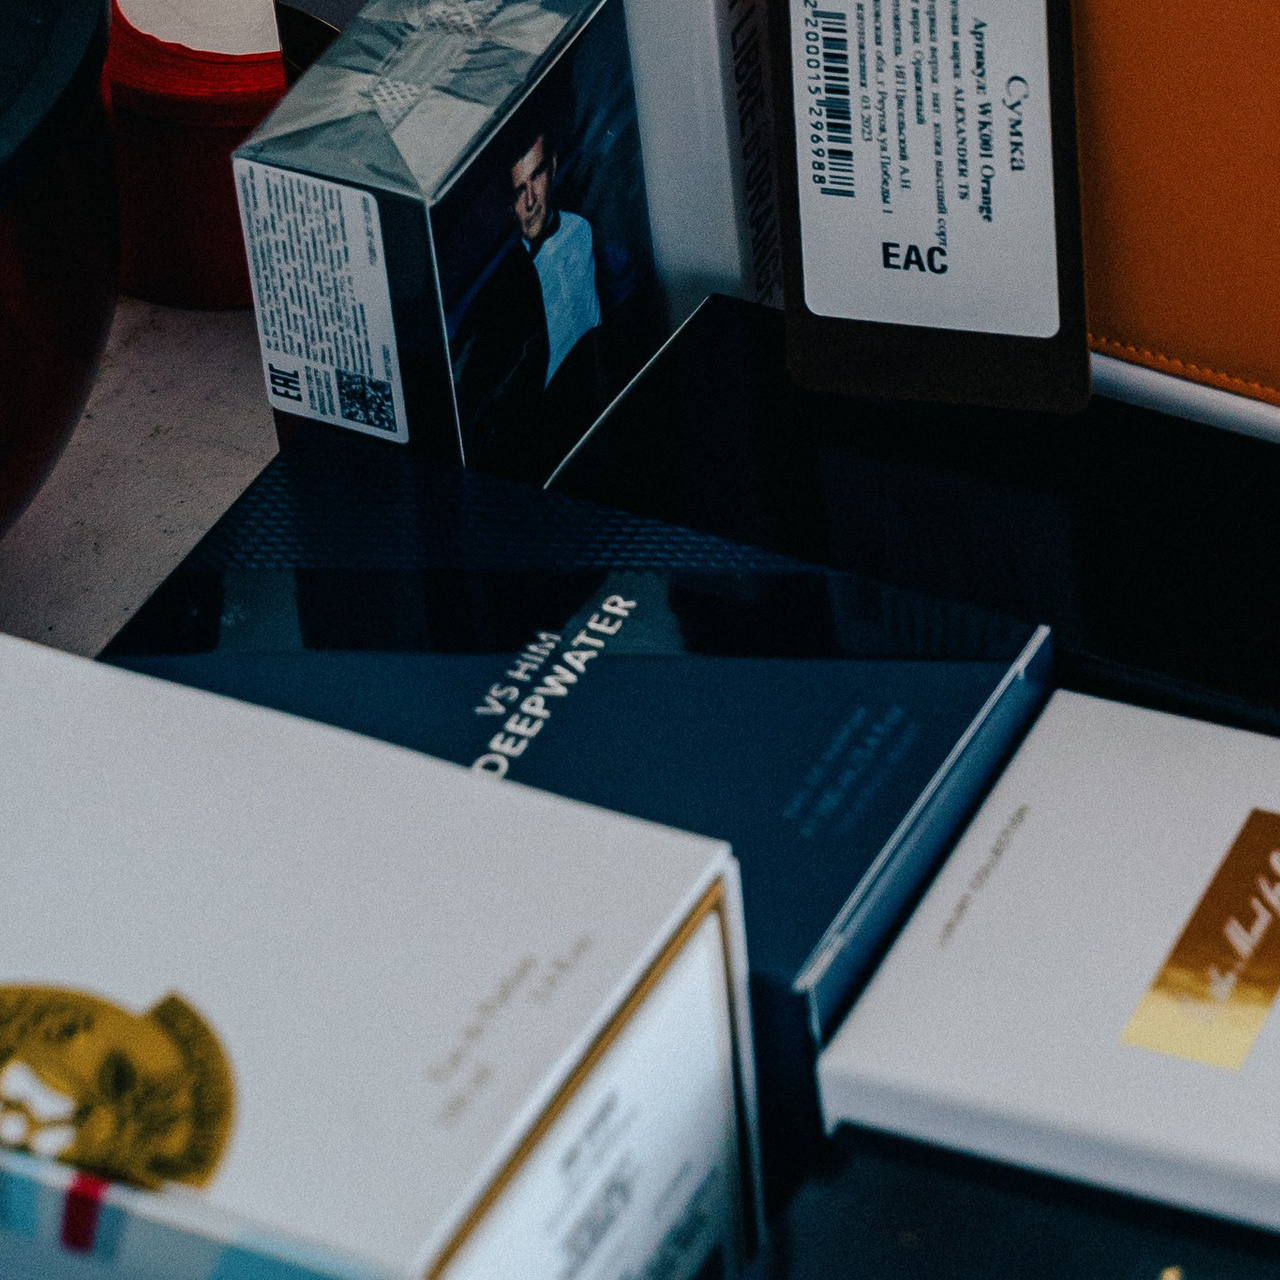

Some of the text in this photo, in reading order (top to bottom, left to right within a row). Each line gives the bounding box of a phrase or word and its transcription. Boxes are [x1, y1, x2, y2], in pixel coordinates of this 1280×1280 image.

[802, 16, 822, 96] 200015
[807, 105, 827, 186] 296988
[951, 85, 970, 177] ALEXANDER
[967, 16, 997, 223] Артикул: WK001 Orange
[1000, 73, 1034, 173] Сумка
[879, 241, 949, 276] EAC
[471, 594, 637, 778] DEEPWATER
[475, 630, 563, 716] VS HIM
